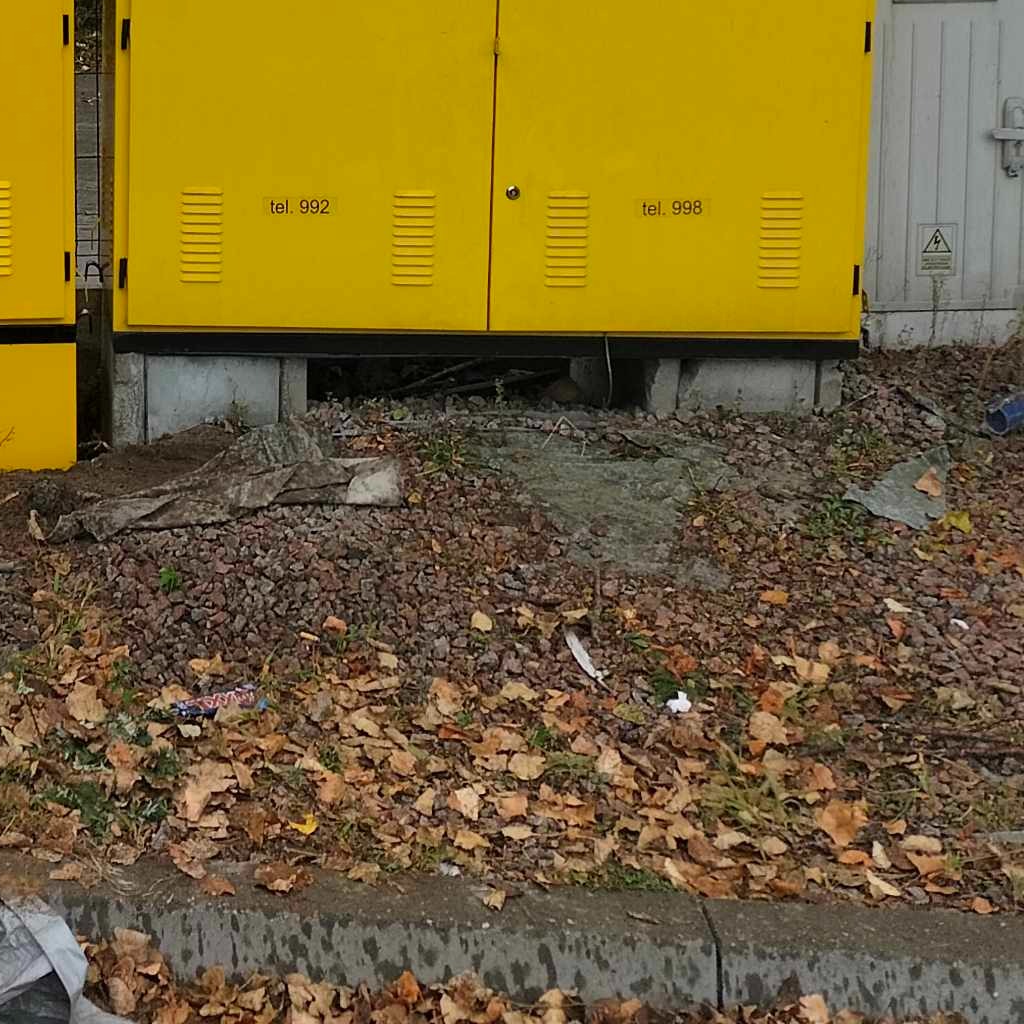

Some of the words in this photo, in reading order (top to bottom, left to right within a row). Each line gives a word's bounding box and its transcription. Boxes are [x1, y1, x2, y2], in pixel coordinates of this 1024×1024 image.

[270, 199, 294, 214] tel.
[299, 199, 330, 215] 992
[642, 200, 666, 216] tel.
[672, 200, 703, 215] 998
